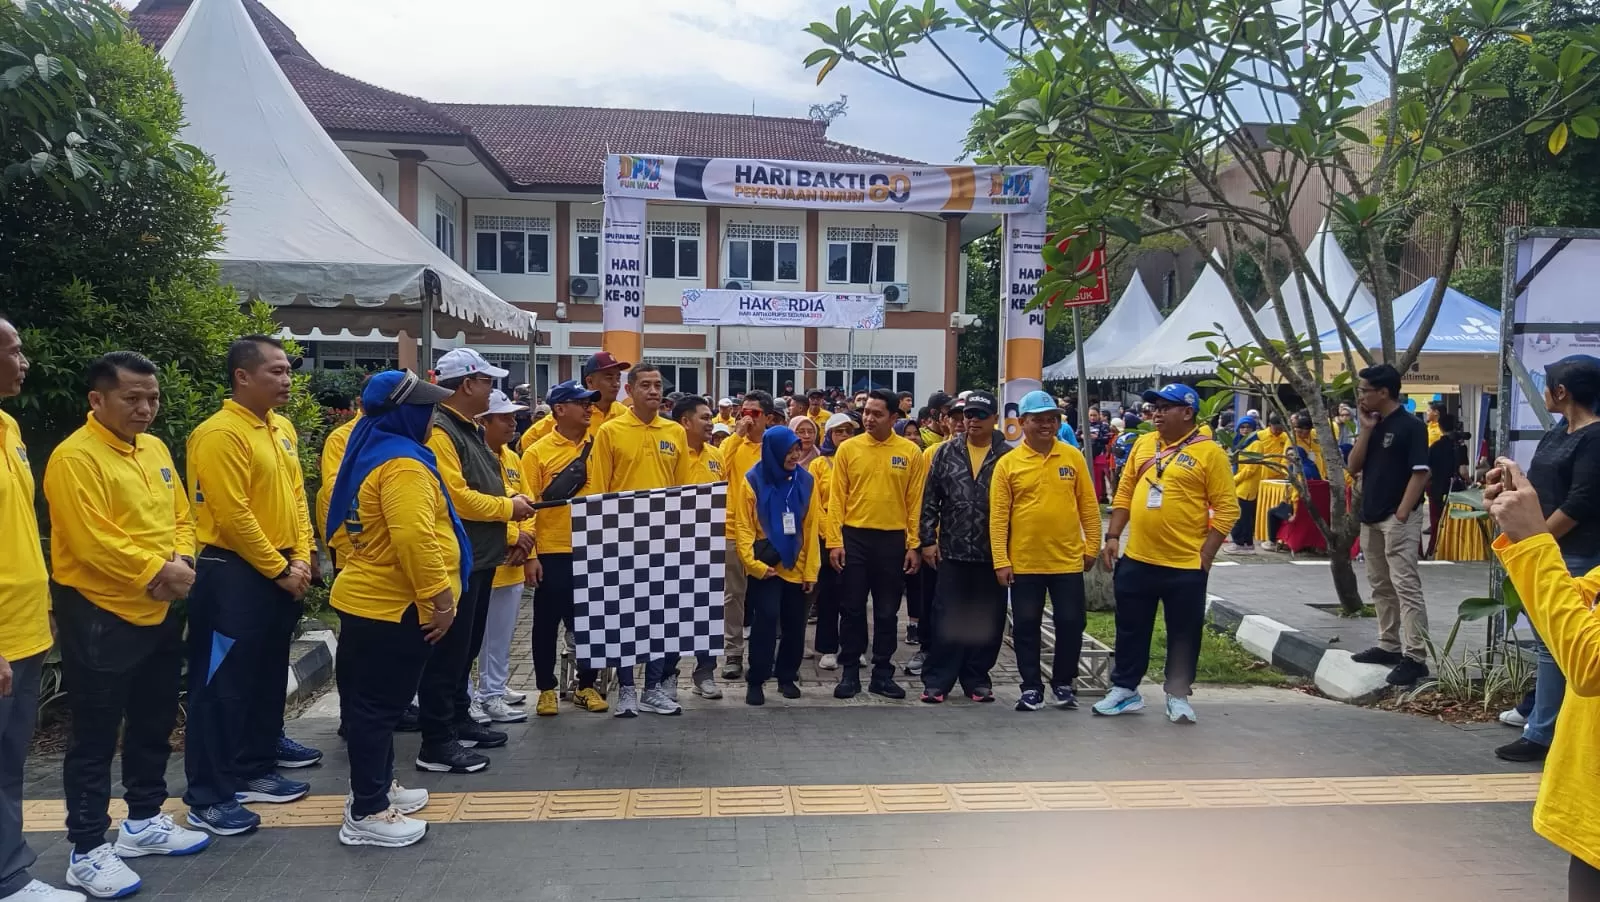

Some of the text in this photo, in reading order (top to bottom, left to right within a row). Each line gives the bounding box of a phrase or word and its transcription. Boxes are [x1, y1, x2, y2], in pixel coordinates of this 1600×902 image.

[619, 180, 659, 190] FUN WALK
[735, 165, 791, 185] HARI
[797, 169, 866, 189] BAKTI
[869, 174, 911, 203] 80
[734, 185, 865, 203] PEKERJAAN UMUM
[611, 259, 640, 271] HARI
[605, 274, 640, 287] BAKTI
[605, 289, 640, 302] KE-80
[624, 306, 640, 317] PU
[1029, 314, 1044, 325] PU
